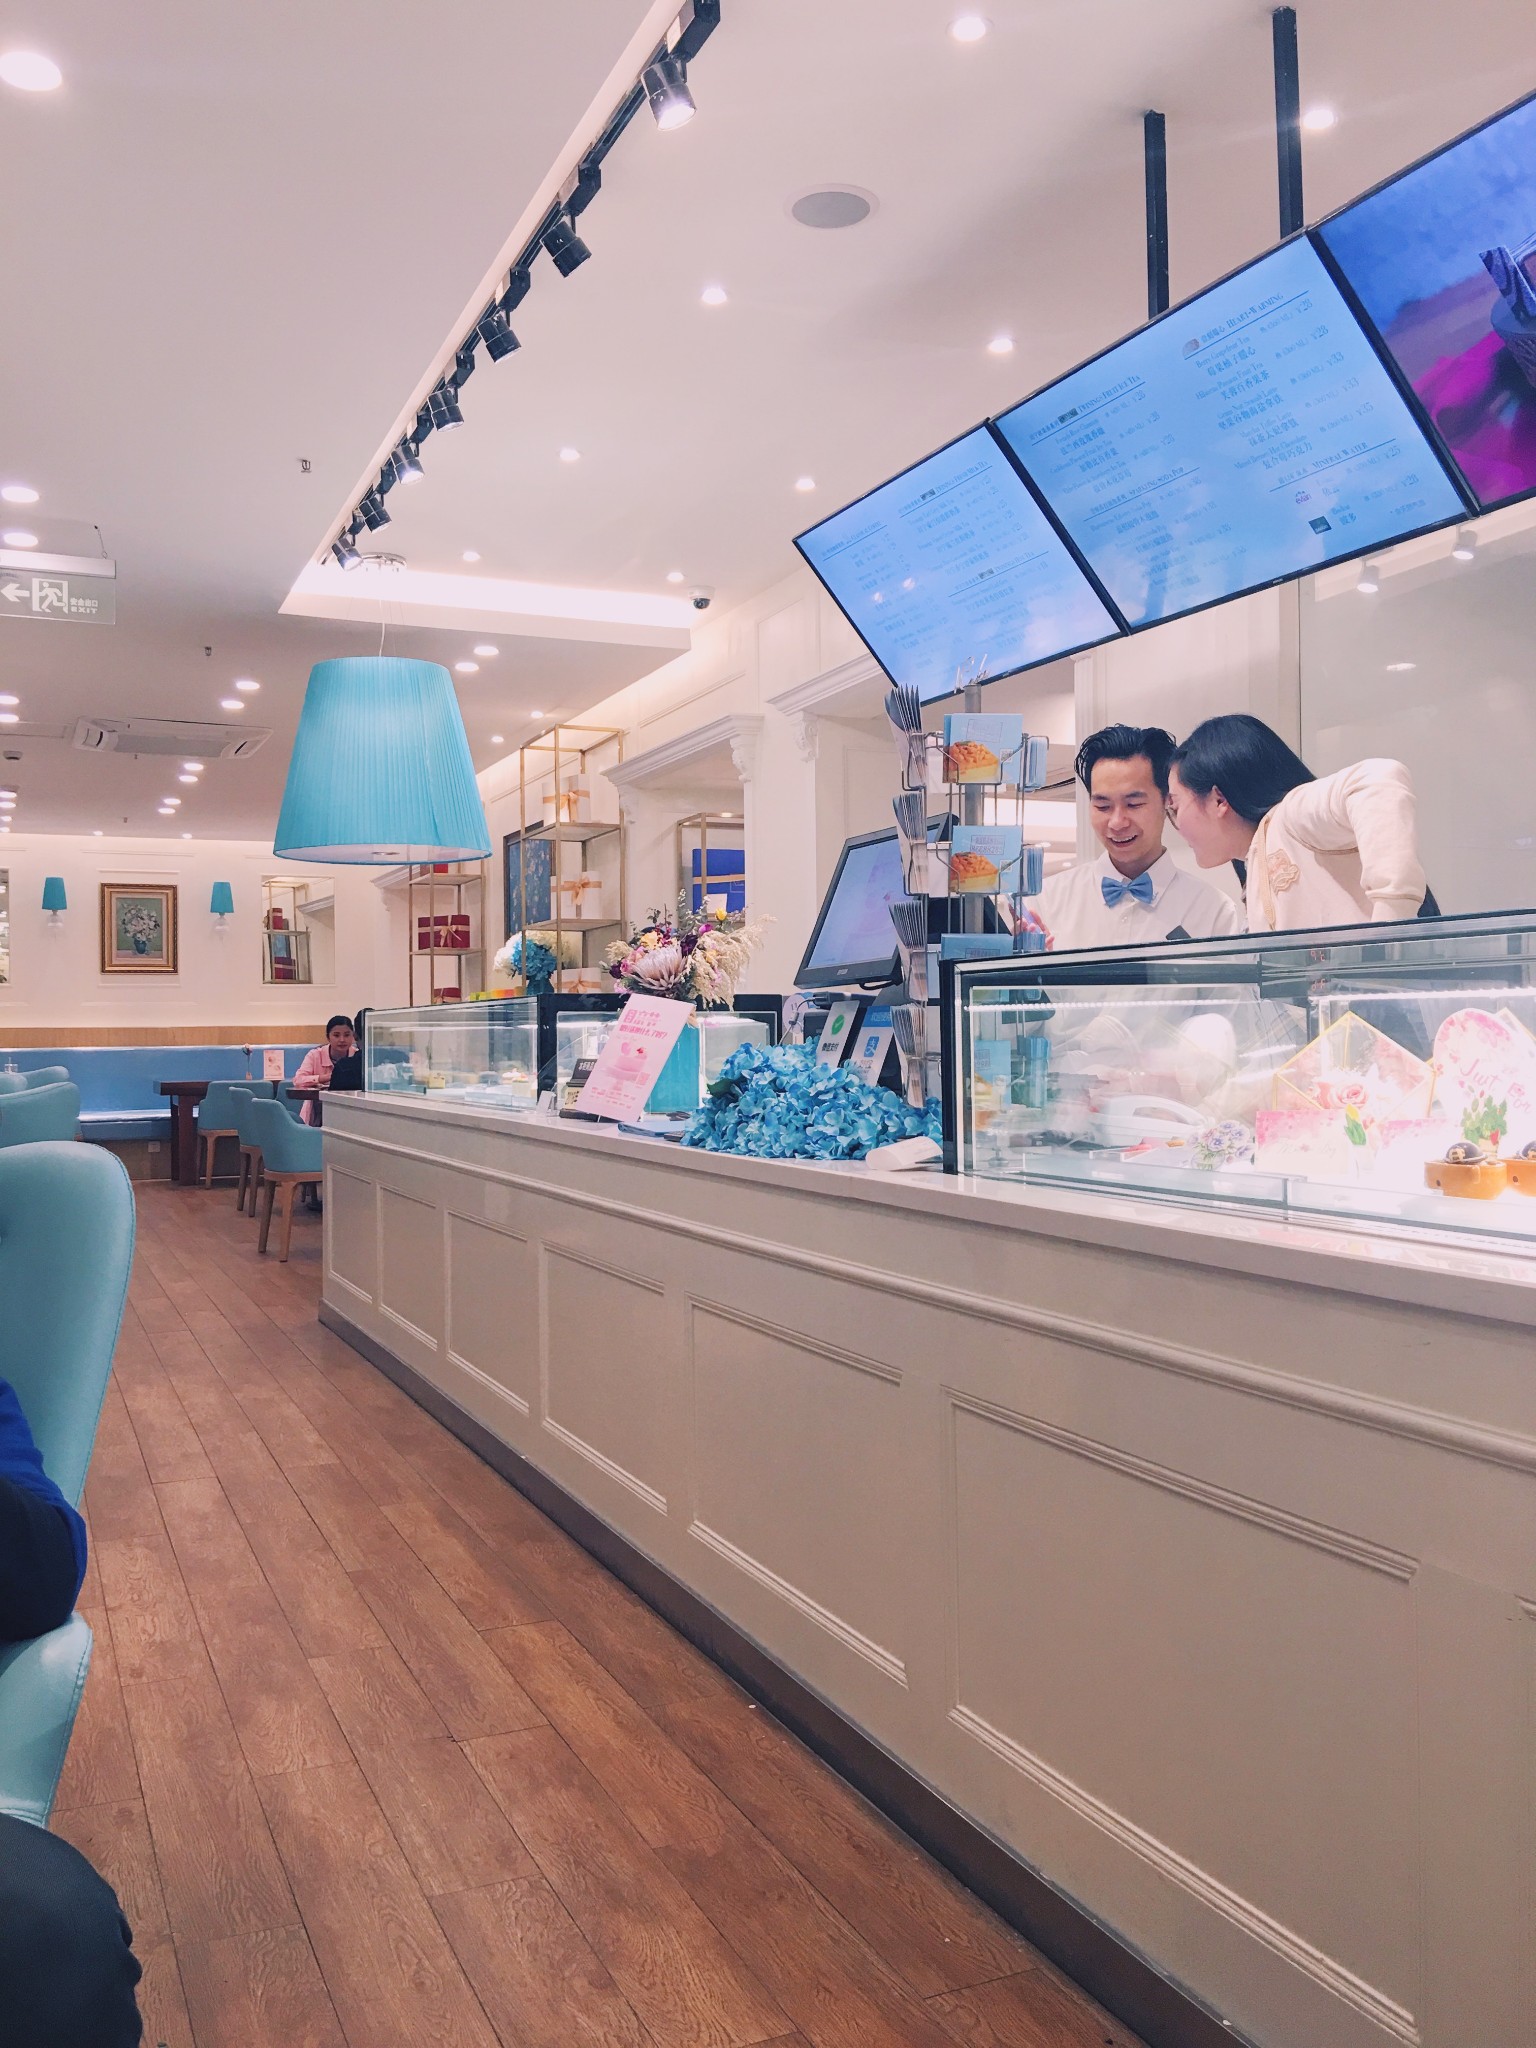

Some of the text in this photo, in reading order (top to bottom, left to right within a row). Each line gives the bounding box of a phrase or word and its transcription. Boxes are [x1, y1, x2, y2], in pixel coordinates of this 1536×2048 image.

[70, 597, 98, 607] 安全出口
[71, 606, 98, 614] EXIT
[822, 1042, 839, 1052] 微信支付
